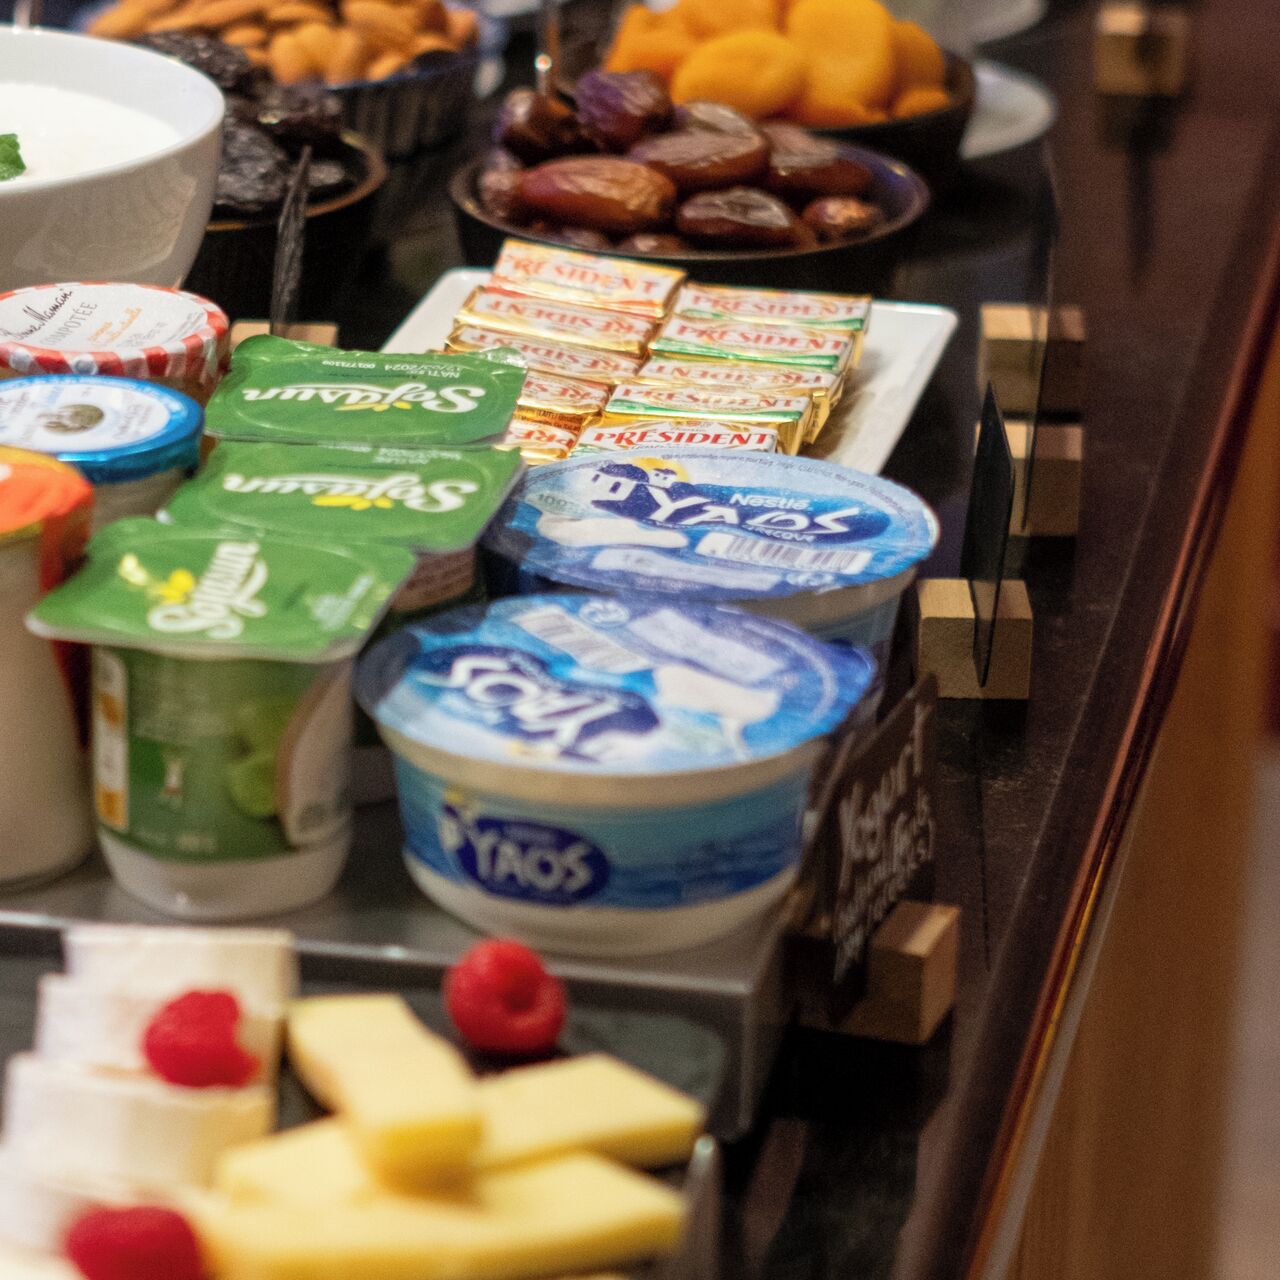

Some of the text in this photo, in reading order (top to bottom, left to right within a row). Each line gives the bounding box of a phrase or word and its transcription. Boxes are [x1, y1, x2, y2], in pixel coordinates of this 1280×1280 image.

[243, 382, 486, 413] Sojasun
[223, 473, 478, 512] Sojasun
[644, 486, 860, 536] YAOS
[472, 823, 595, 893] YAOS
